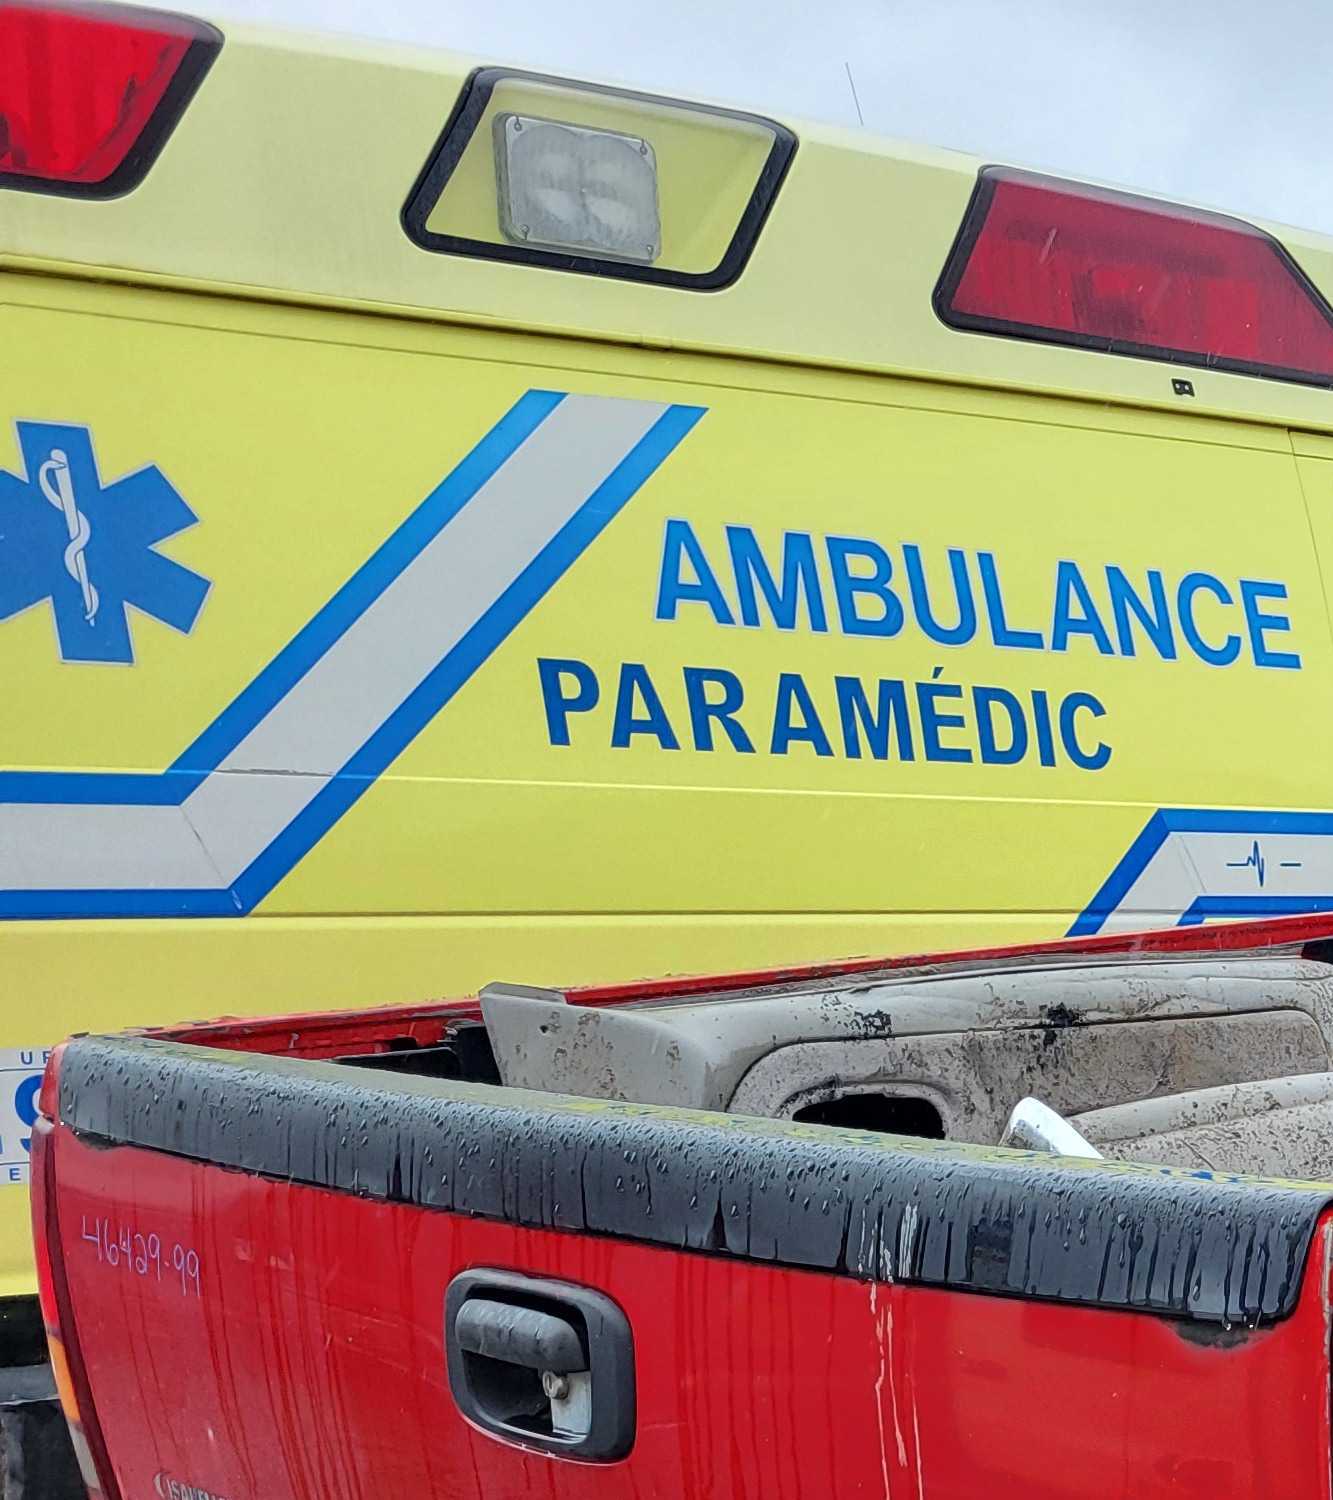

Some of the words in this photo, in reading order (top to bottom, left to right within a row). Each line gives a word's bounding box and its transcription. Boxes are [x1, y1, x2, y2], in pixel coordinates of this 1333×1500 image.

[655, 518, 1303, 671] AMBULANCE
[537, 658, 1113, 771] PARAMÉDIC
[81, 1215, 200, 1297] 46429-99
